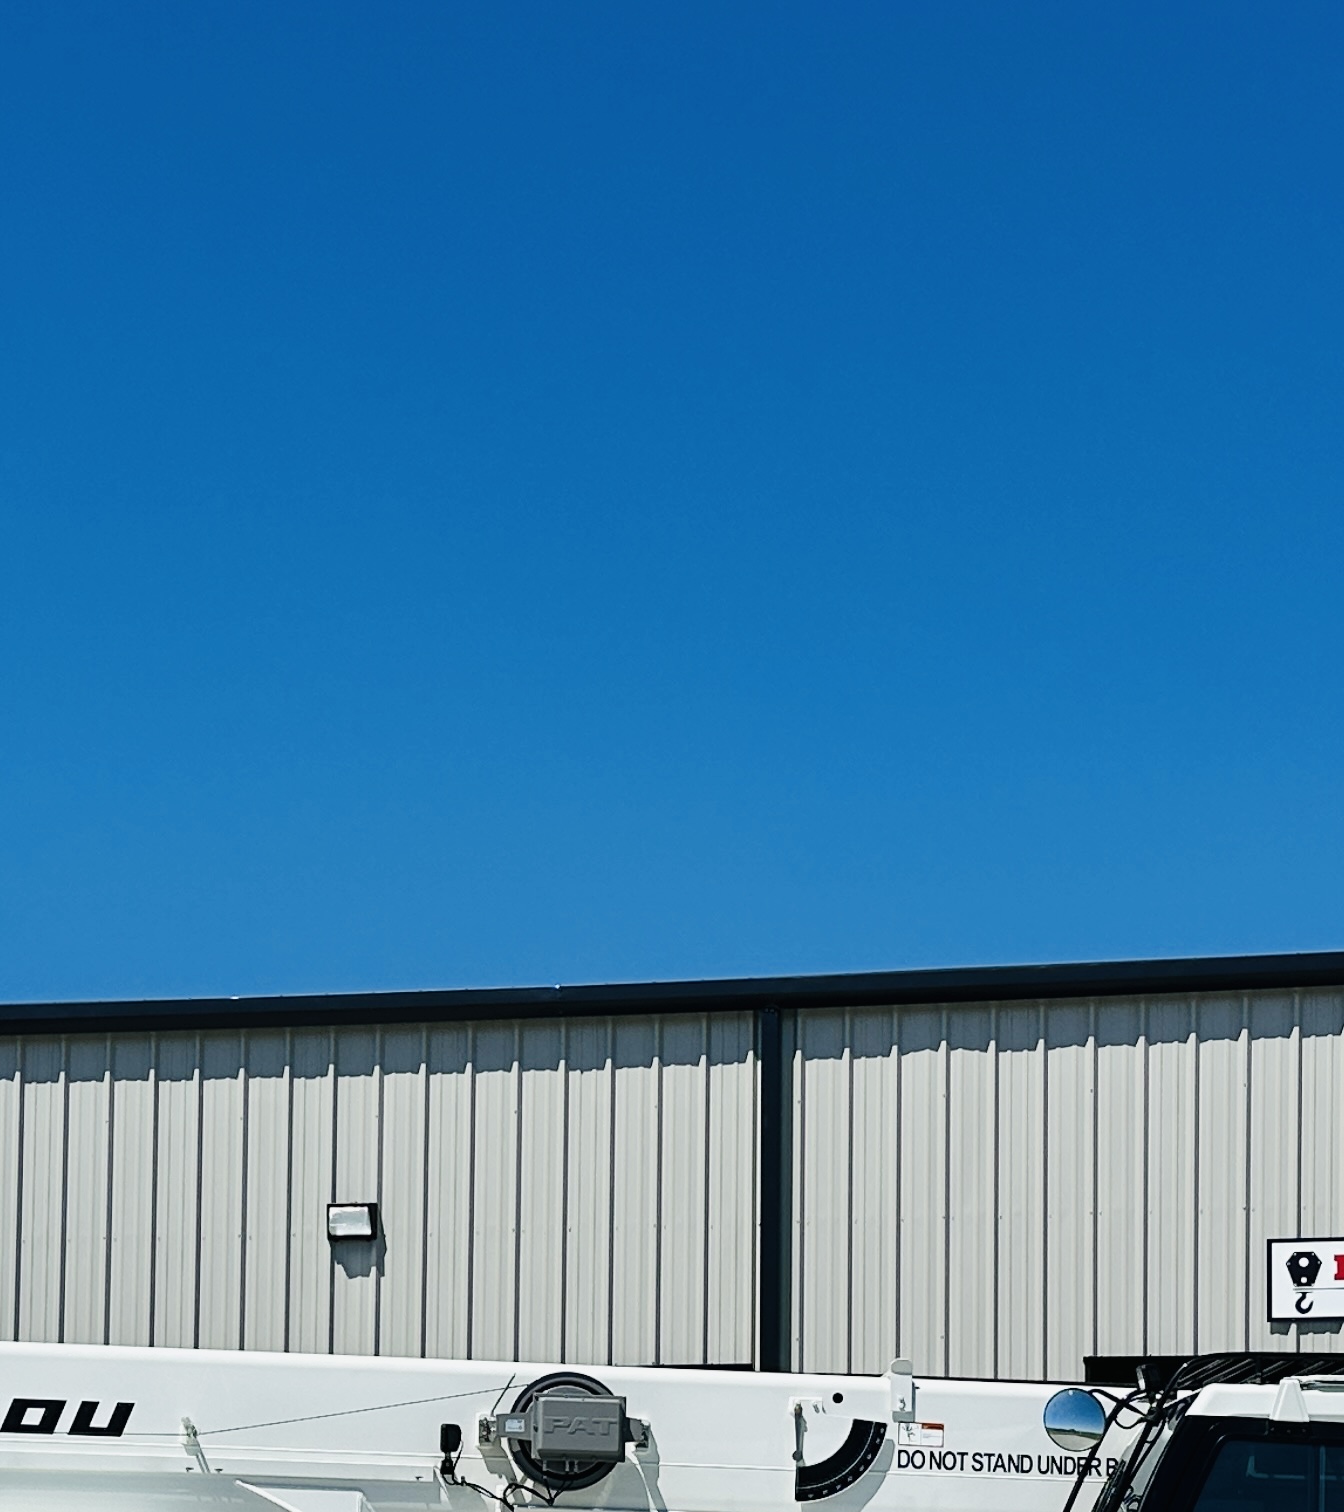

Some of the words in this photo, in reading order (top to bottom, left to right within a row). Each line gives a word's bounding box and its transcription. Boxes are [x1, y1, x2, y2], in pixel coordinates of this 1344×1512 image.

[543, 1416, 618, 1436] PAT
[897, 1449, 926, 1470] DO
[929, 1450, 969, 1471] NOT
[971, 1452, 1034, 1474] STAND
[1037, 1455, 1102, 1477] UNDER
